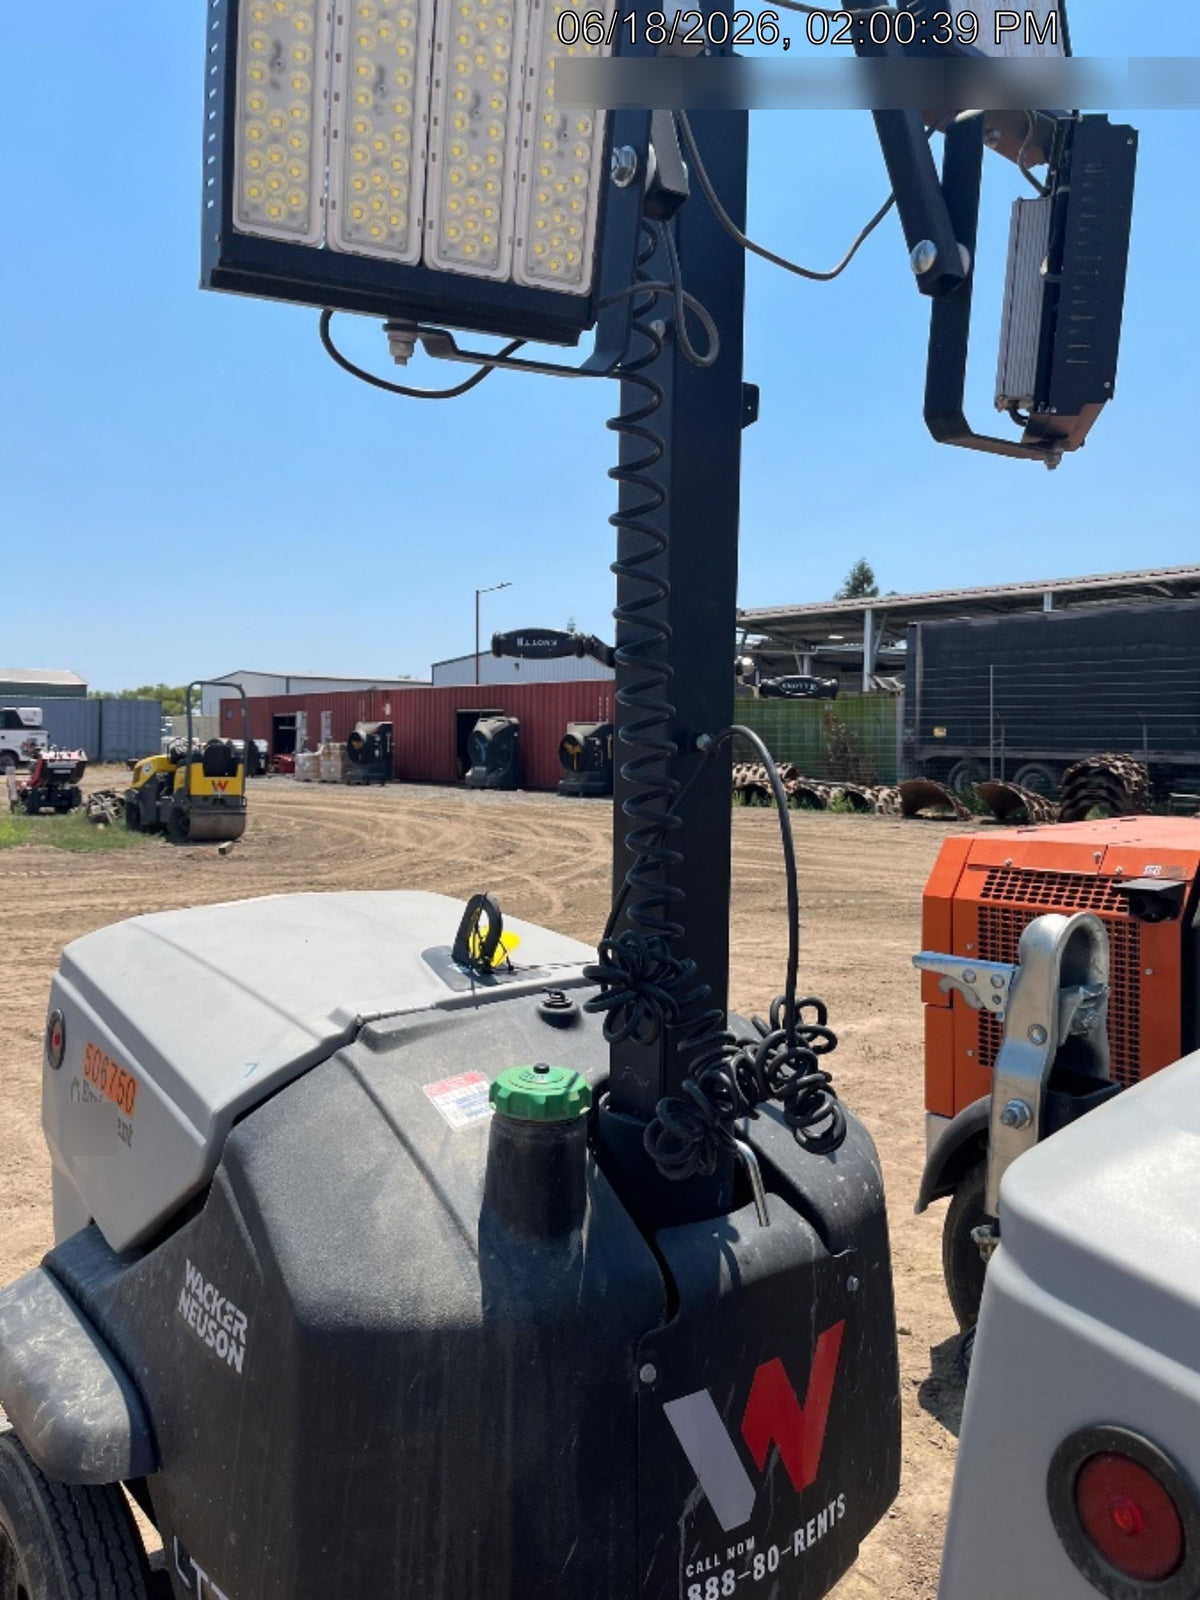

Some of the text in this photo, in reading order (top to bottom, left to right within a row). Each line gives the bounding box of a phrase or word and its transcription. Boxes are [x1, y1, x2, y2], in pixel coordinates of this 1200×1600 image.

[178, 1286, 246, 1375] NEUSON
[185, 1258, 248, 1345] WACKER
[685, 1535, 756, 1578] CALL NOW
